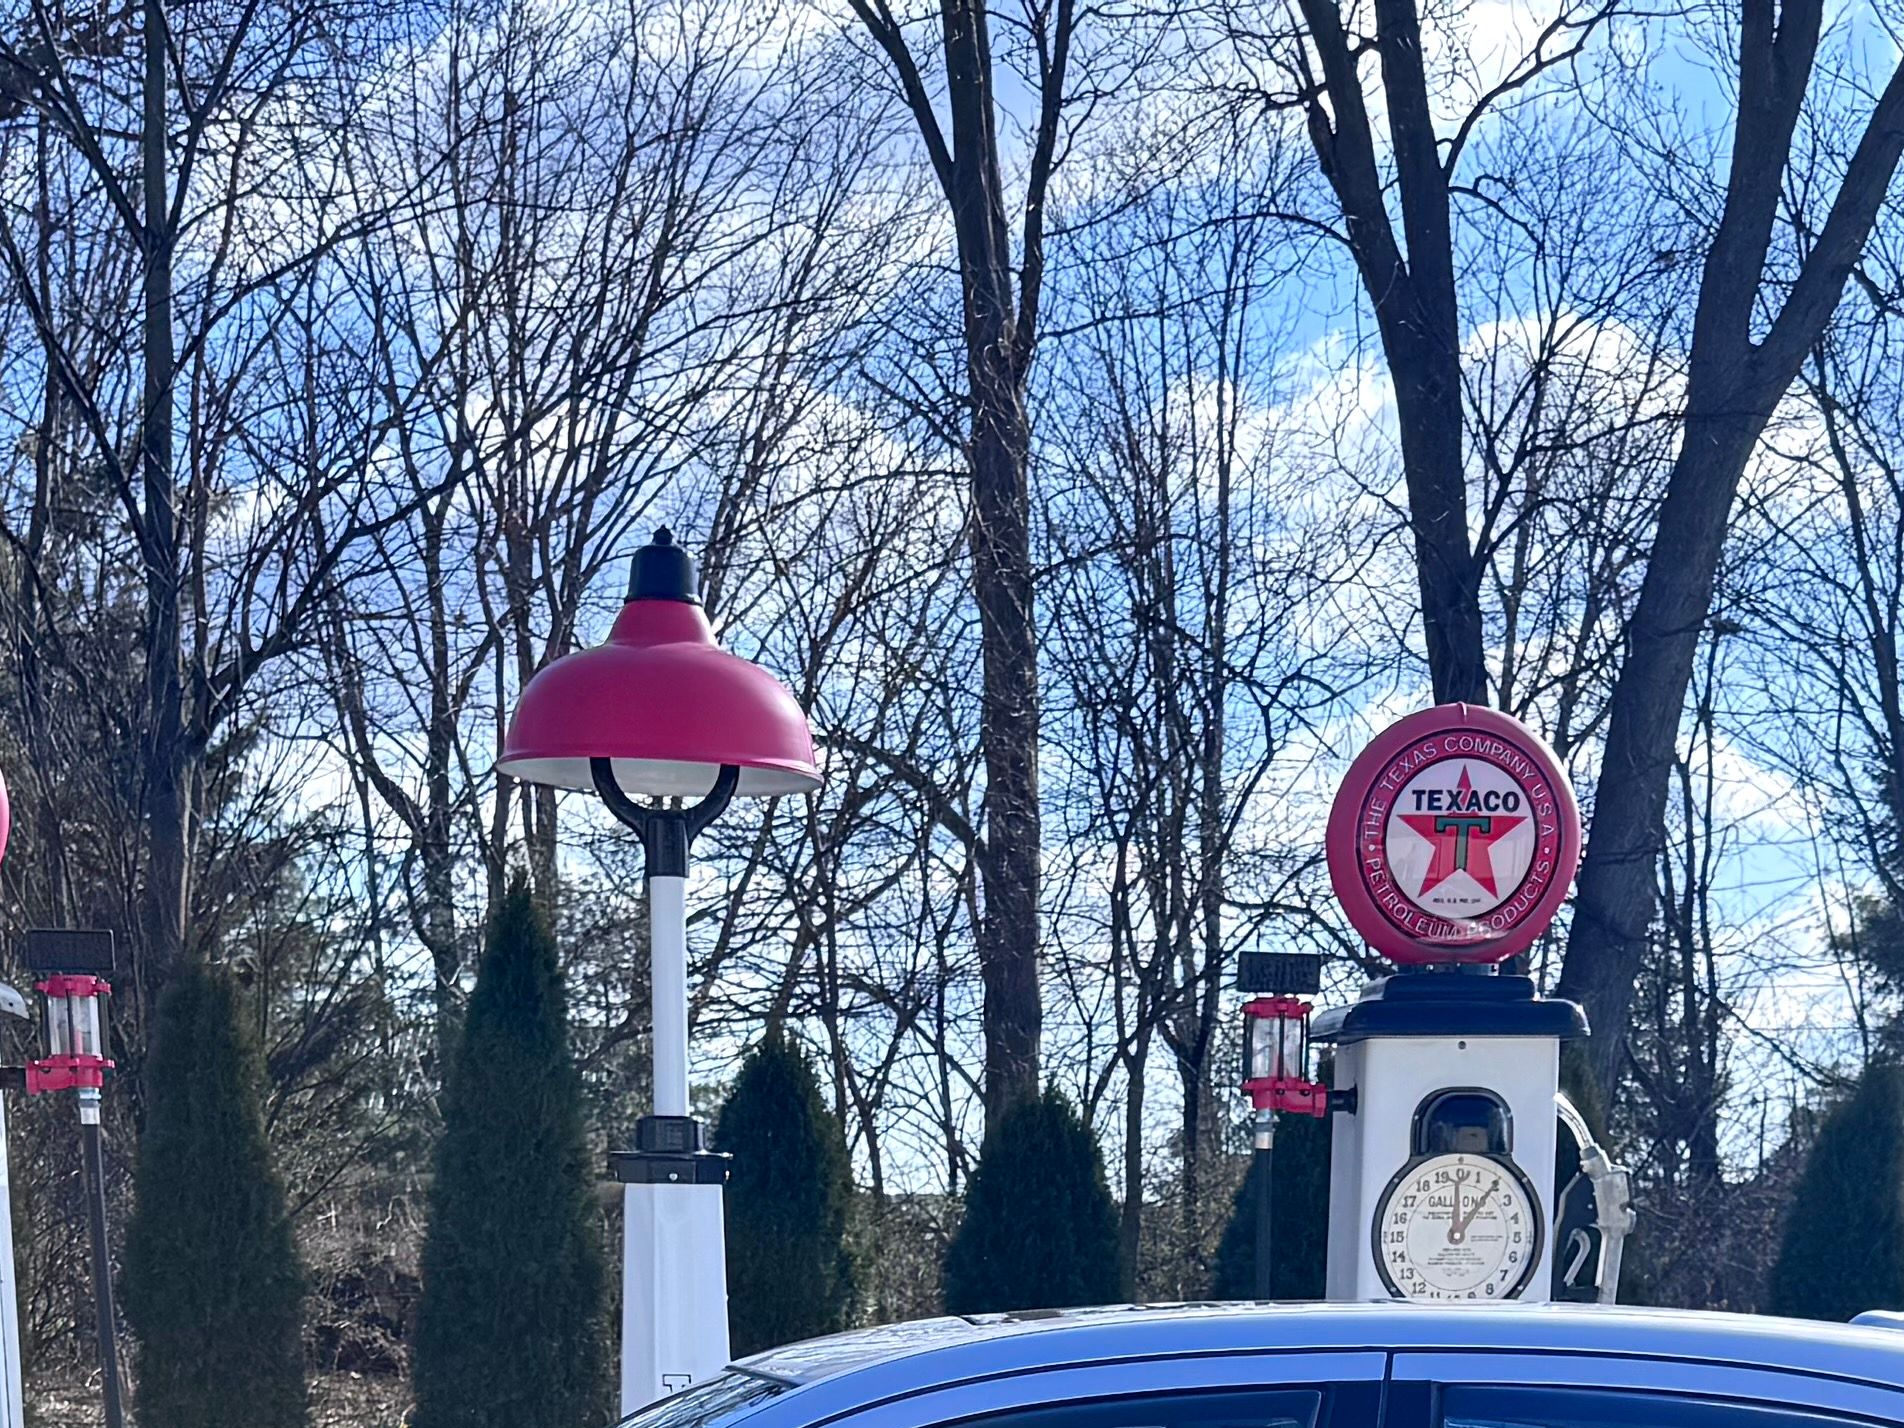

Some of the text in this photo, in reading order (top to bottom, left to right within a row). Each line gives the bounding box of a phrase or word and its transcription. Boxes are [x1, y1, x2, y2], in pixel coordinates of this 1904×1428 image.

[1364, 797, 1386, 840] THE
[1379, 742, 1437, 792] TEXAS
[1444, 736, 1536, 780] COMPANY
[1412, 789, 1520, 813] TEXACO
[1366, 858, 1460, 939] PETROLEUM
[1435, 1171, 1449, 1183] 19
[1475, 1171, 1481, 1184] 1
[1416, 1180, 1430, 1192] 18
[1403, 1195, 1417, 1207] 17
[1503, 1194, 1512, 1207] 3
[1393, 1212, 1407, 1225] 16
[1510, 1212, 1519, 1224] 4
[1390, 1231, 1405, 1243] 15
[1513, 1231, 1521, 1244] 5
[1392, 1251, 1405, 1263] 14
[1508, 1251, 1517, 1263] 6
[1400, 1268, 1414, 1280] 13
[1500, 1269, 1509, 1281] 7
[1412, 1282, 1426, 1294] 12
[1485, 1283, 1494, 1295] 8
